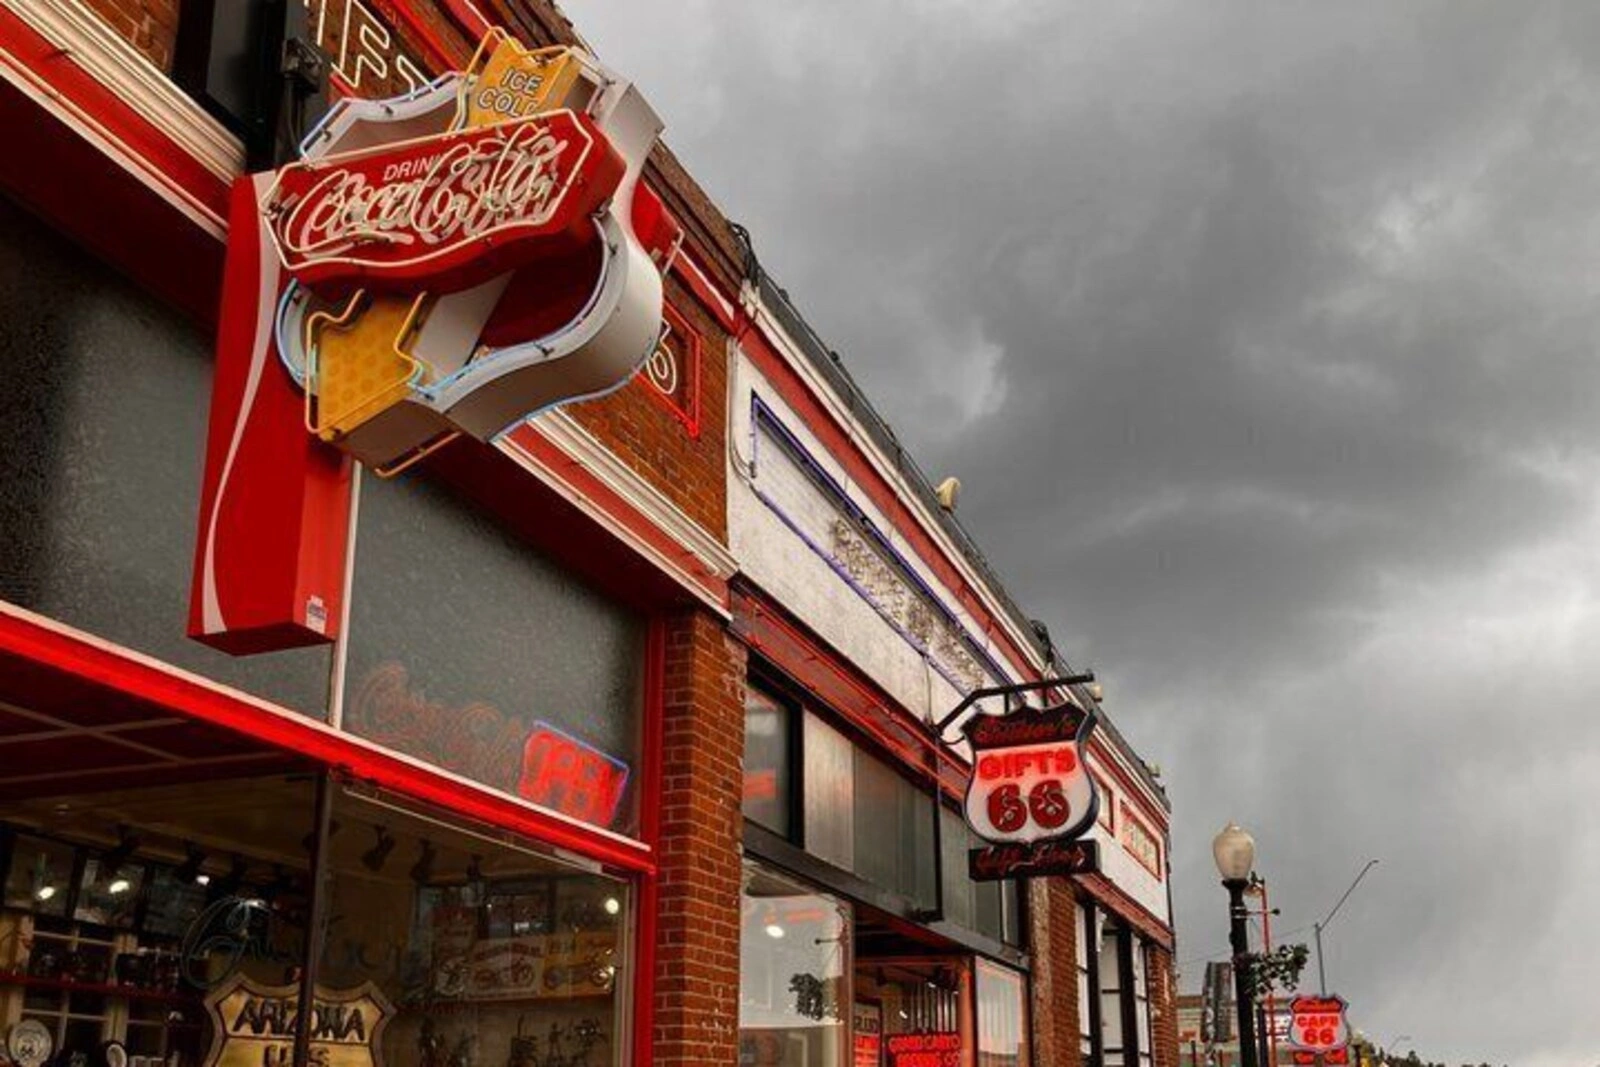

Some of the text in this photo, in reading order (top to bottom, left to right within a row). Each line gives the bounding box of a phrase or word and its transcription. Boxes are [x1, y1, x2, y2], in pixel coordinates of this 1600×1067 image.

[501, 66, 542, 96] ICE
[383, 154, 438, 181] DRIN
[979, 748, 1076, 781] GIFTS
[987, 779, 1071, 833] 66
